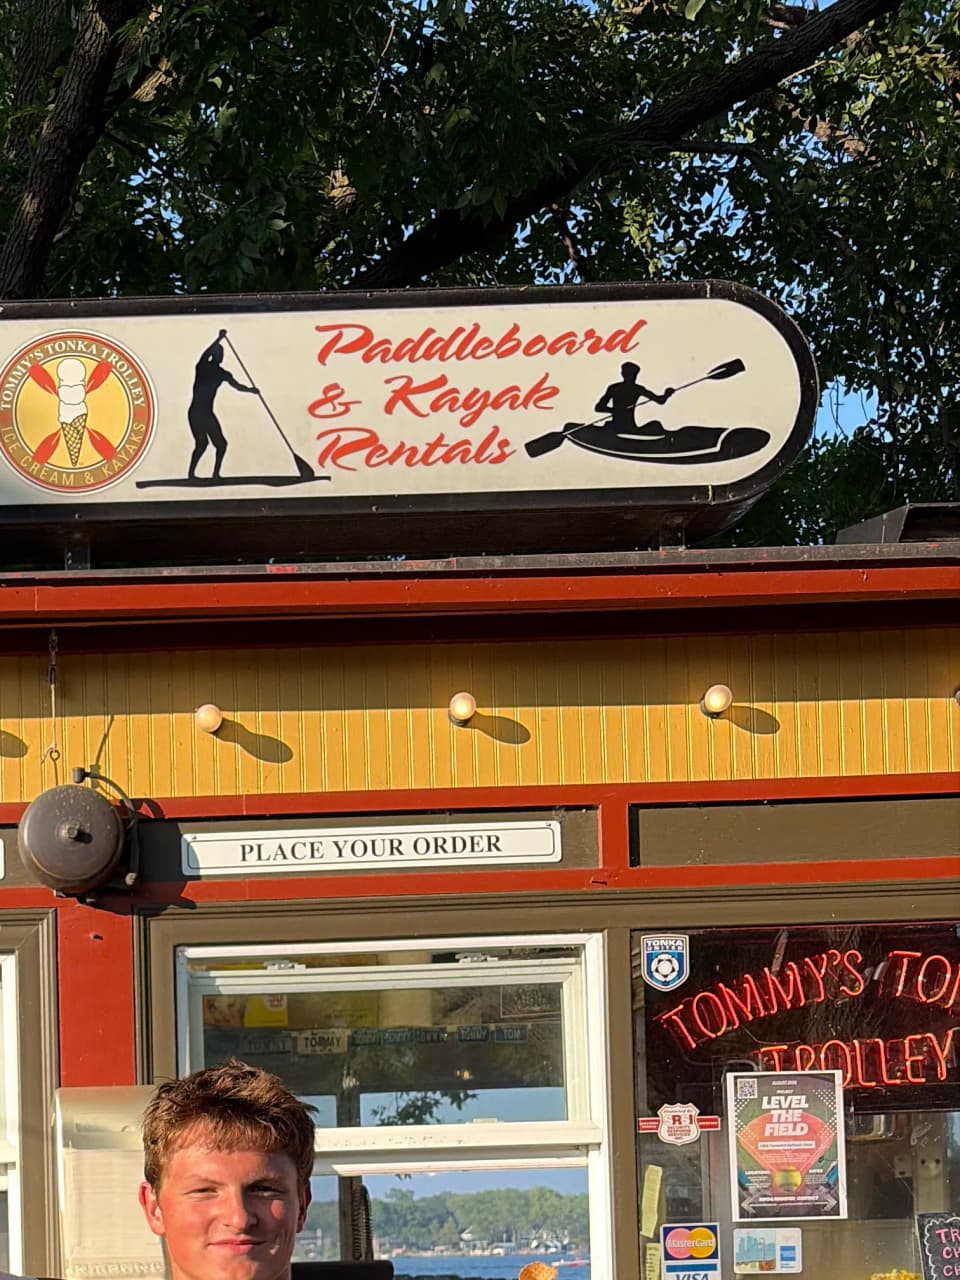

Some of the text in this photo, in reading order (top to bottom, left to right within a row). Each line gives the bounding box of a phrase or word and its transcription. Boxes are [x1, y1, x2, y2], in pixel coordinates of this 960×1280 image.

[315, 319, 648, 365] Paddleboard
[0, 340, 146, 411] TOMMY'S TONKA TROLLEY
[308, 372, 561, 428] & Kayak
[1, 423, 146, 486] ICE CREAM & KAYAKS
[317, 425, 517, 471] Rentals
[240, 834, 503, 862] PLACE YOUR ORDER
[661, 950, 960, 1049] TOMMY'S TO
[762, 1095, 808, 1109] LEVEL
[770, 1109, 803, 1122] THE
[764, 1123, 808, 1136] FIELD
